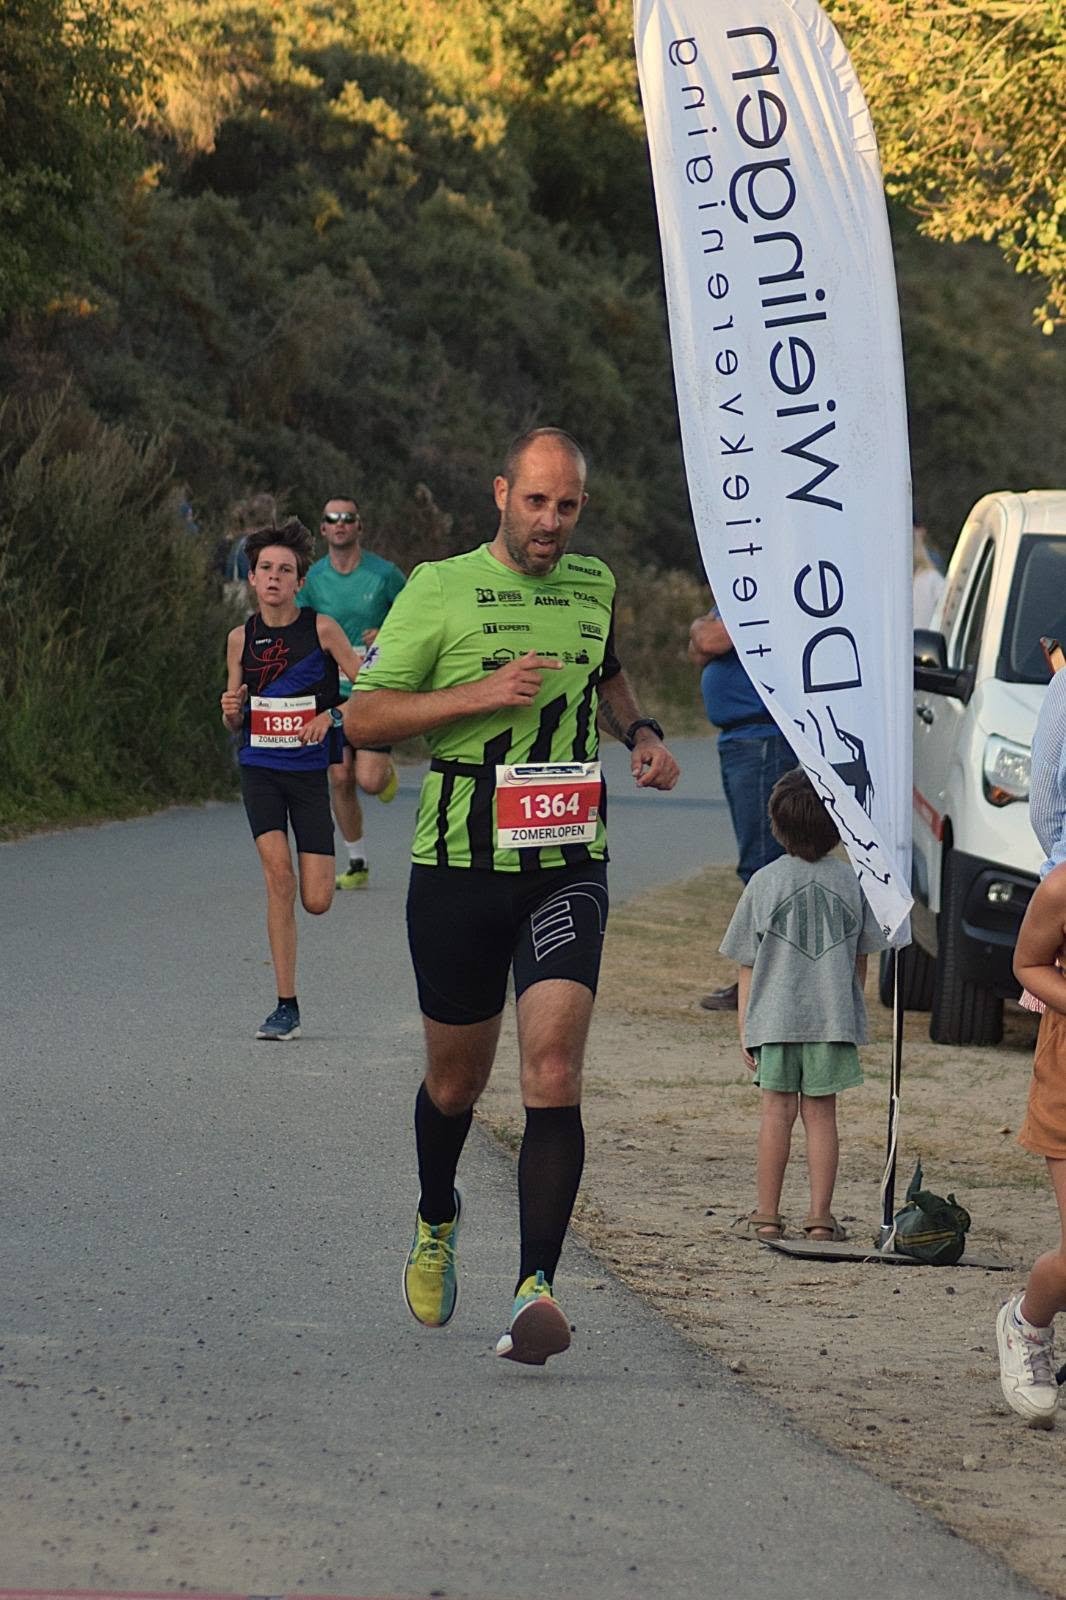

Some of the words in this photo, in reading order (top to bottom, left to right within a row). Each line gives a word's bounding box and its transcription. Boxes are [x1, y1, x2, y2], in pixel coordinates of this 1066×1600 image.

[534, 596, 570, 607] Athlex
[498, 624, 530, 632] EXPERTS
[263, 716, 304, 731] 1382
[258, 735, 299, 743] ZOMERLOP
[519, 792, 580, 819] 1364
[511, 825, 585, 841] ZOMERLOPEN
